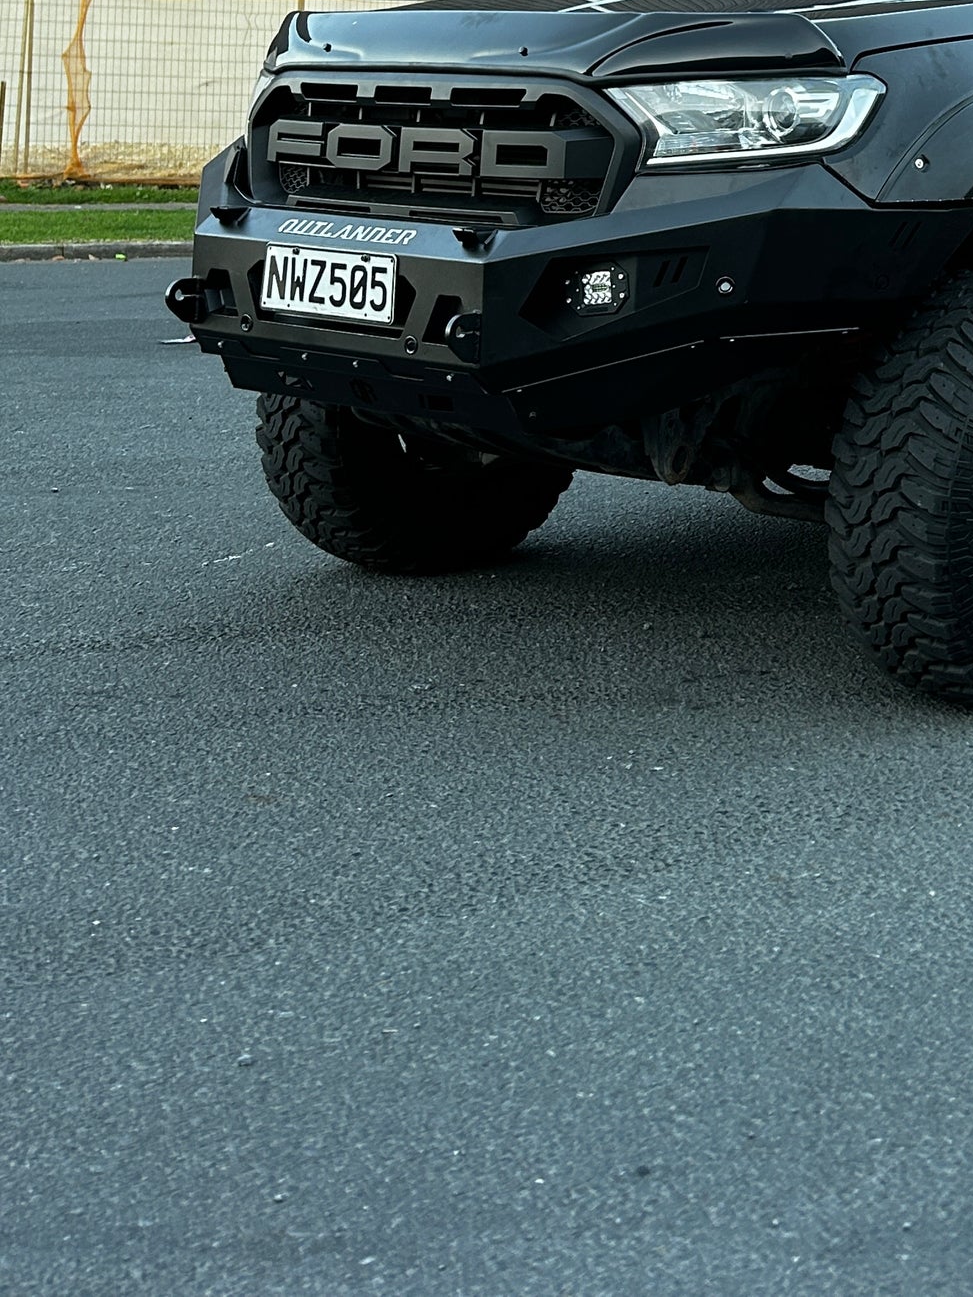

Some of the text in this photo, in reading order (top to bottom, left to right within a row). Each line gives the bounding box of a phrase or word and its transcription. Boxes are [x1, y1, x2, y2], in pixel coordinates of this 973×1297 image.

[267, 119, 566, 178] FORD
[277, 218, 417, 245] OUTLANDER
[266, 255, 388, 312] NWZ505
